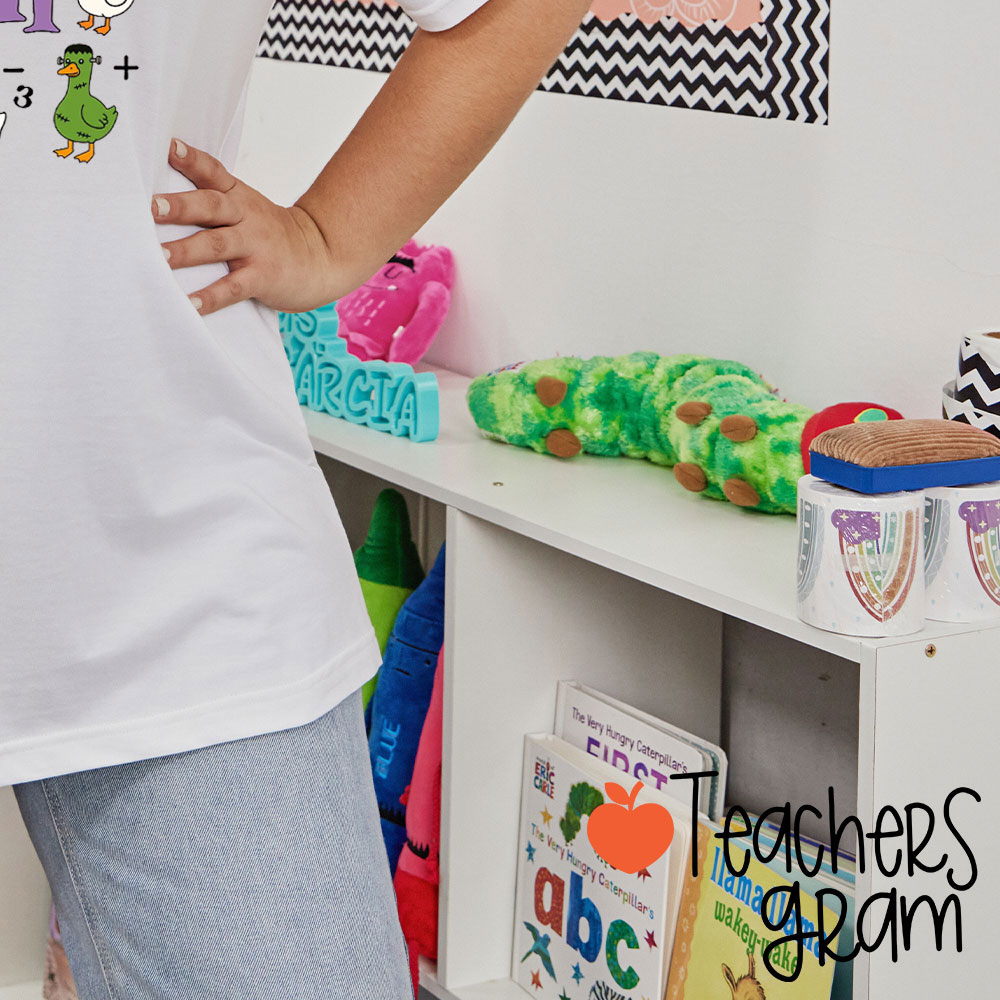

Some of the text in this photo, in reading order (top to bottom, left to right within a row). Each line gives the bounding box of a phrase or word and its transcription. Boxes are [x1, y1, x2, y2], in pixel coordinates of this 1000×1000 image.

[13, 85, 34, 109] 3
[294, 352, 421, 438] ARCIA
[375, 718, 401, 779] BLUE
[534, 761, 555, 786] ERIC
[572, 706, 688, 775] The Very Hungry Caterpillar's
[533, 775, 555, 800] CARLE
[531, 822, 654, 920] The Very Hungry Caterpillar's
[710, 846, 764, 916] llama
[534, 866, 640, 990] abc
